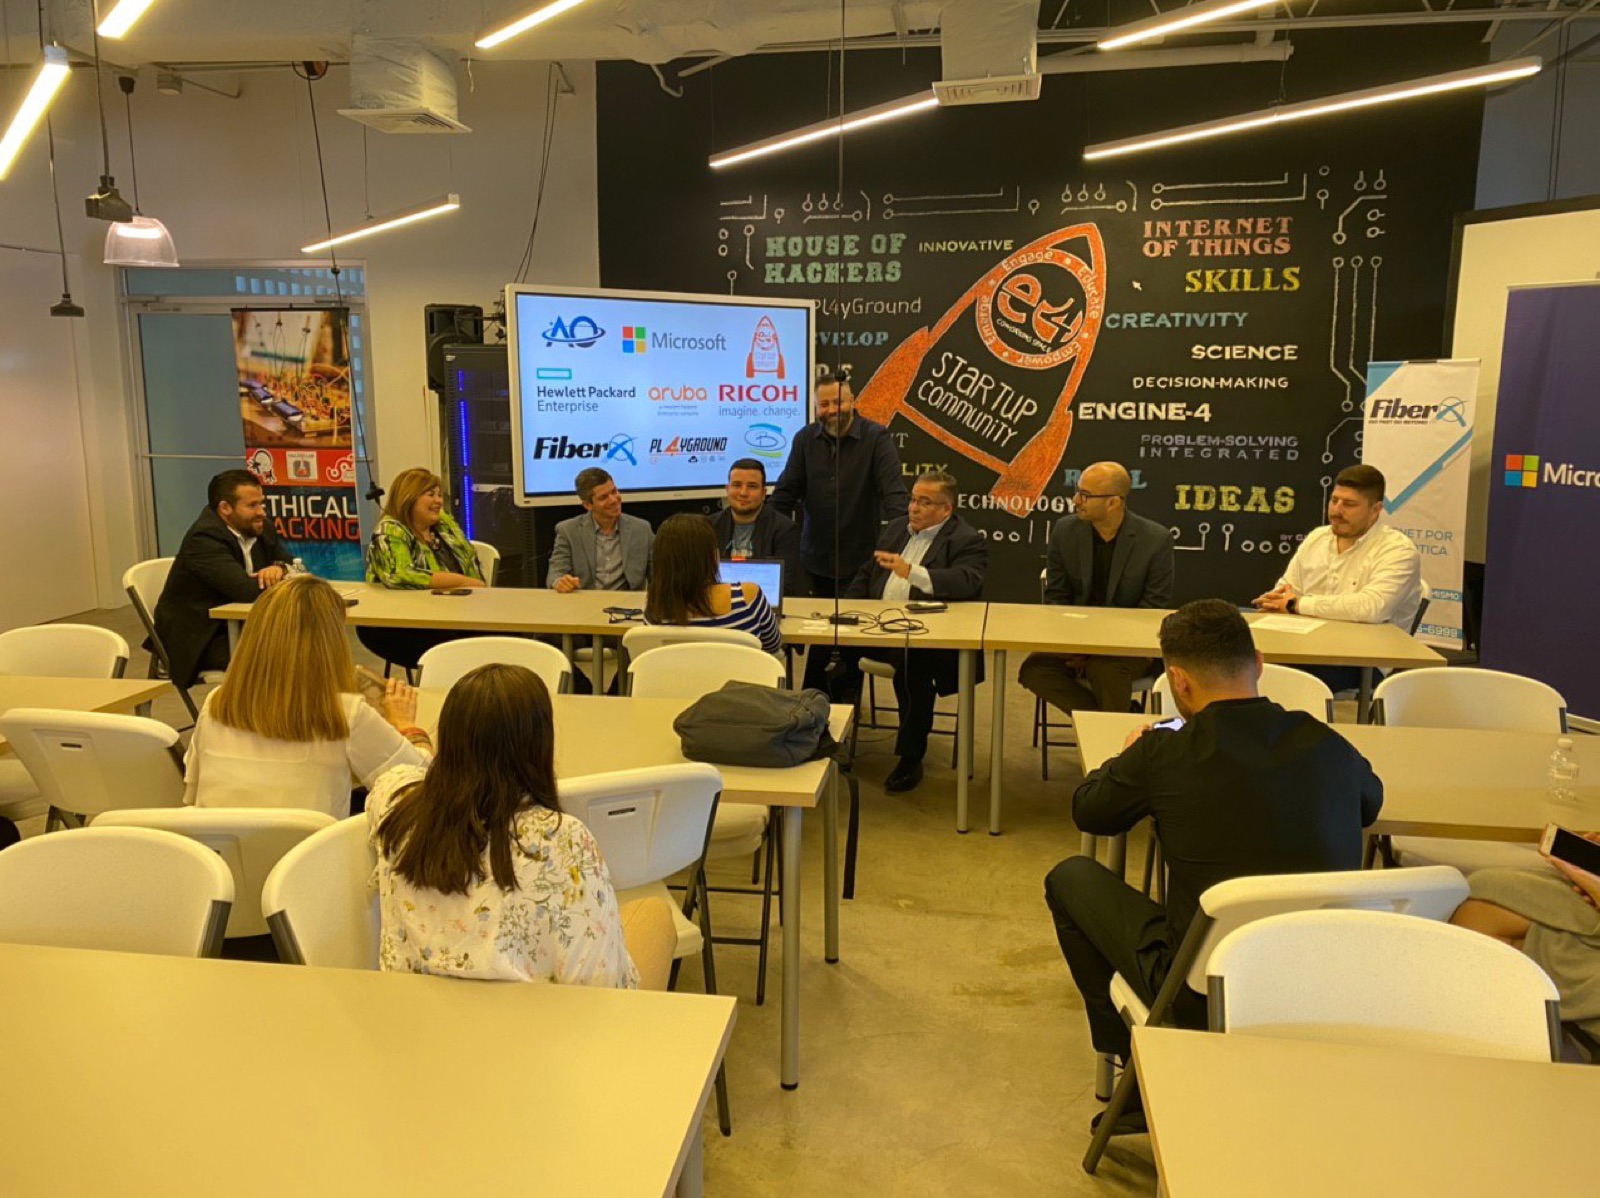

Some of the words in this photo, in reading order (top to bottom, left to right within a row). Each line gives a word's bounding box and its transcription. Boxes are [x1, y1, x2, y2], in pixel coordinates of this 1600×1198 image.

[1143, 217, 1293, 238] INTERNET
[765, 234, 860, 257] HOUSE
[871, 233, 907, 254] OF
[919, 239, 1014, 253] INNOVATIVE
[1142, 239, 1178, 258] OF
[1187, 237, 1292, 258] THINGS
[1002, 251, 1053, 272] Engage
[764, 260, 902, 283] HACKERS
[1185, 266, 1301, 293] SKILLS
[1077, 266, 1100, 318] Educate
[1105, 312, 1249, 329] CREATIVITY
[652, 332, 727, 351] Microsoft
[815, 331, 889, 346] VELOP
[1191, 345, 1298, 361] SCIENCE
[1133, 376, 1289, 390] DECISION-MAKING
[537, 386, 586, 398] Hewlett
[589, 386, 636, 399] Packard
[648, 385, 708, 401] aruba
[719, 385, 798, 402] RICOH
[537, 400, 599, 414] Enterprise
[763, 406, 800, 420] change.
[1078, 401, 1212, 422] ENGINE-4
[1141, 434, 1299, 447] PROBLEM-SOLVING
[1140, 447, 1299, 461] INTEGRATED
[901, 462, 948, 477] LITY
[1064, 469, 1148, 490] RL
[266, 495, 358, 518] THICAL
[957, 493, 1076, 513] ECHNOLOGY
[1174, 484, 1296, 514] IDEAS
[274, 517, 360, 539] ACKING
[1425, 529, 1453, 541] POR
[1415, 543, 1448, 555] TICA
